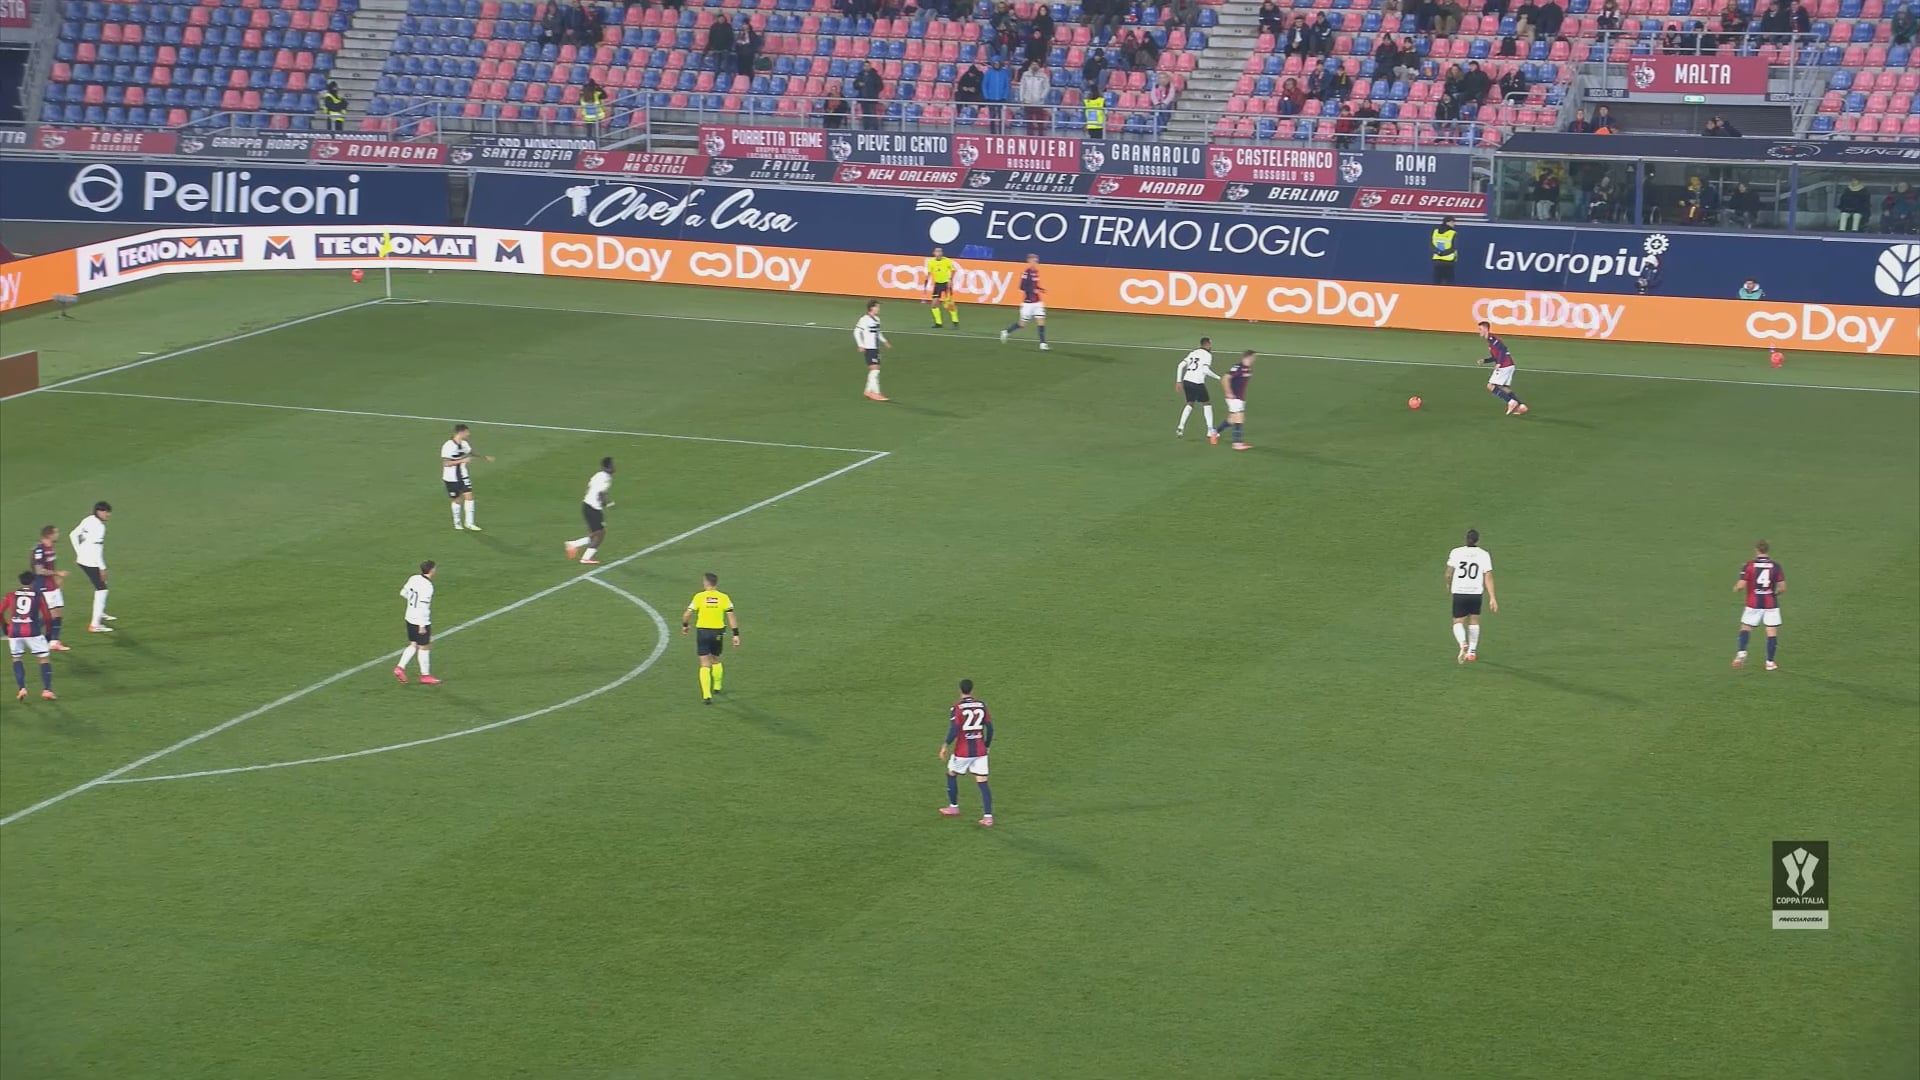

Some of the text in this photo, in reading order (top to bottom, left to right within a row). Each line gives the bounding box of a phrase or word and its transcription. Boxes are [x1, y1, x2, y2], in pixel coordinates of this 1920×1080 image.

[1675, 63, 1731, 84] MALTA
[90, 131, 144, 144] TOGHE
[211, 136, 309, 150] GRAPPA KORPS
[731, 129, 823, 148] PORRETTA TERME
[857, 134, 948, 154] PIEVE DI CENTO
[347, 143, 439, 160] ROMAGNA
[481, 147, 574, 161] SANTA SOFIA
[985, 137, 1075, 158] TRANVIERI
[1111, 143, 1201, 165] GRANAROLO
[627, 153, 688, 164] DISTINTI
[761, 160, 810, 172] FRIUL
[1007, 158, 1052, 170] ROSSOBLU
[1236, 147, 1333, 169] CASTELFRANCO
[1395, 154, 1437, 173] ROMA
[623, 162, 685, 174] MA OSTICI
[867, 169, 958, 183] NEW ORLEANS
[1132, 164, 1179, 177] ROSSOBLU
[1253, 168, 1297, 182] ROSSOBLU
[1008, 171, 1080, 185] PHUKET
[1404, 175, 1428, 186] 1989
[144, 171, 360, 216] Pelliconi
[1025, 184, 1049, 192] CLUB
[1051, 185, 1075, 193] 2015
[1138, 181, 1205, 196] MADRID
[1267, 186, 1341, 202] BERLINO
[1389, 193, 1484, 209] GLI SPECIALI
[588, 186, 799, 233] Chef a Casa
[985, 210, 1330, 259] ECO TERMO LOGIC
[118, 237, 239, 268] TECNOMAT
[318, 235, 473, 257] TECNOMAT
[1186, 357, 1200, 371] 23
[1458, 561, 1479, 580] 30
[1756, 568, 1772, 588] 4
[16, 596, 32, 615] 9
[962, 708, 985, 731] 22
